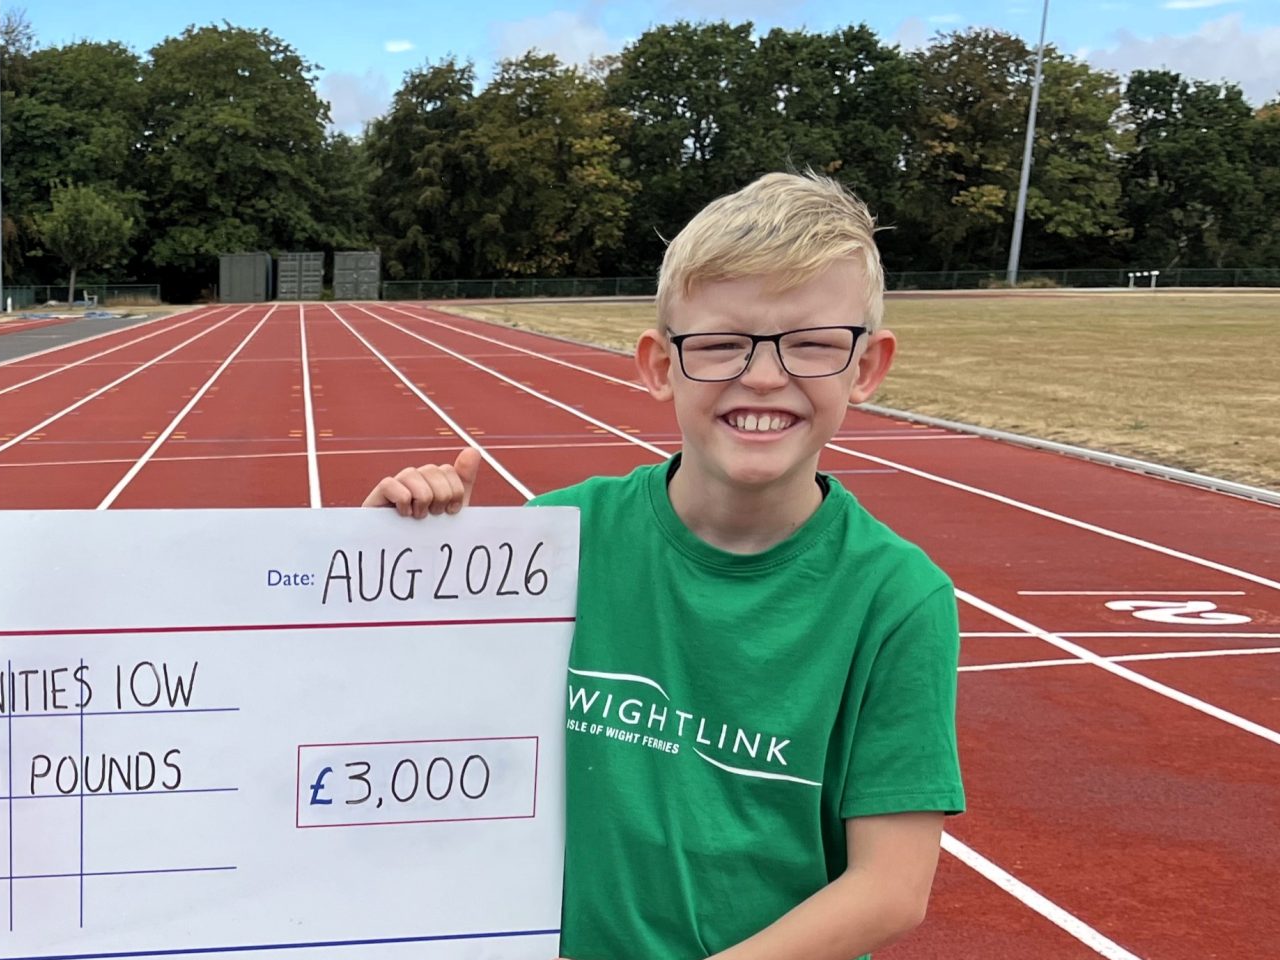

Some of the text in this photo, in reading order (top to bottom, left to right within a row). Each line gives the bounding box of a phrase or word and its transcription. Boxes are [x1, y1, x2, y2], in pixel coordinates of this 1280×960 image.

[267, 569, 315, 587] Date:
[322, 542, 549, 604] AUG 2026
[116, 661, 198, 711] IOW
[566, 719, 680, 754] ISLE OF WIGHT FERRIES
[568, 685, 790, 765] WIGHTLINK
[30, 749, 182, 796] POUNDS
